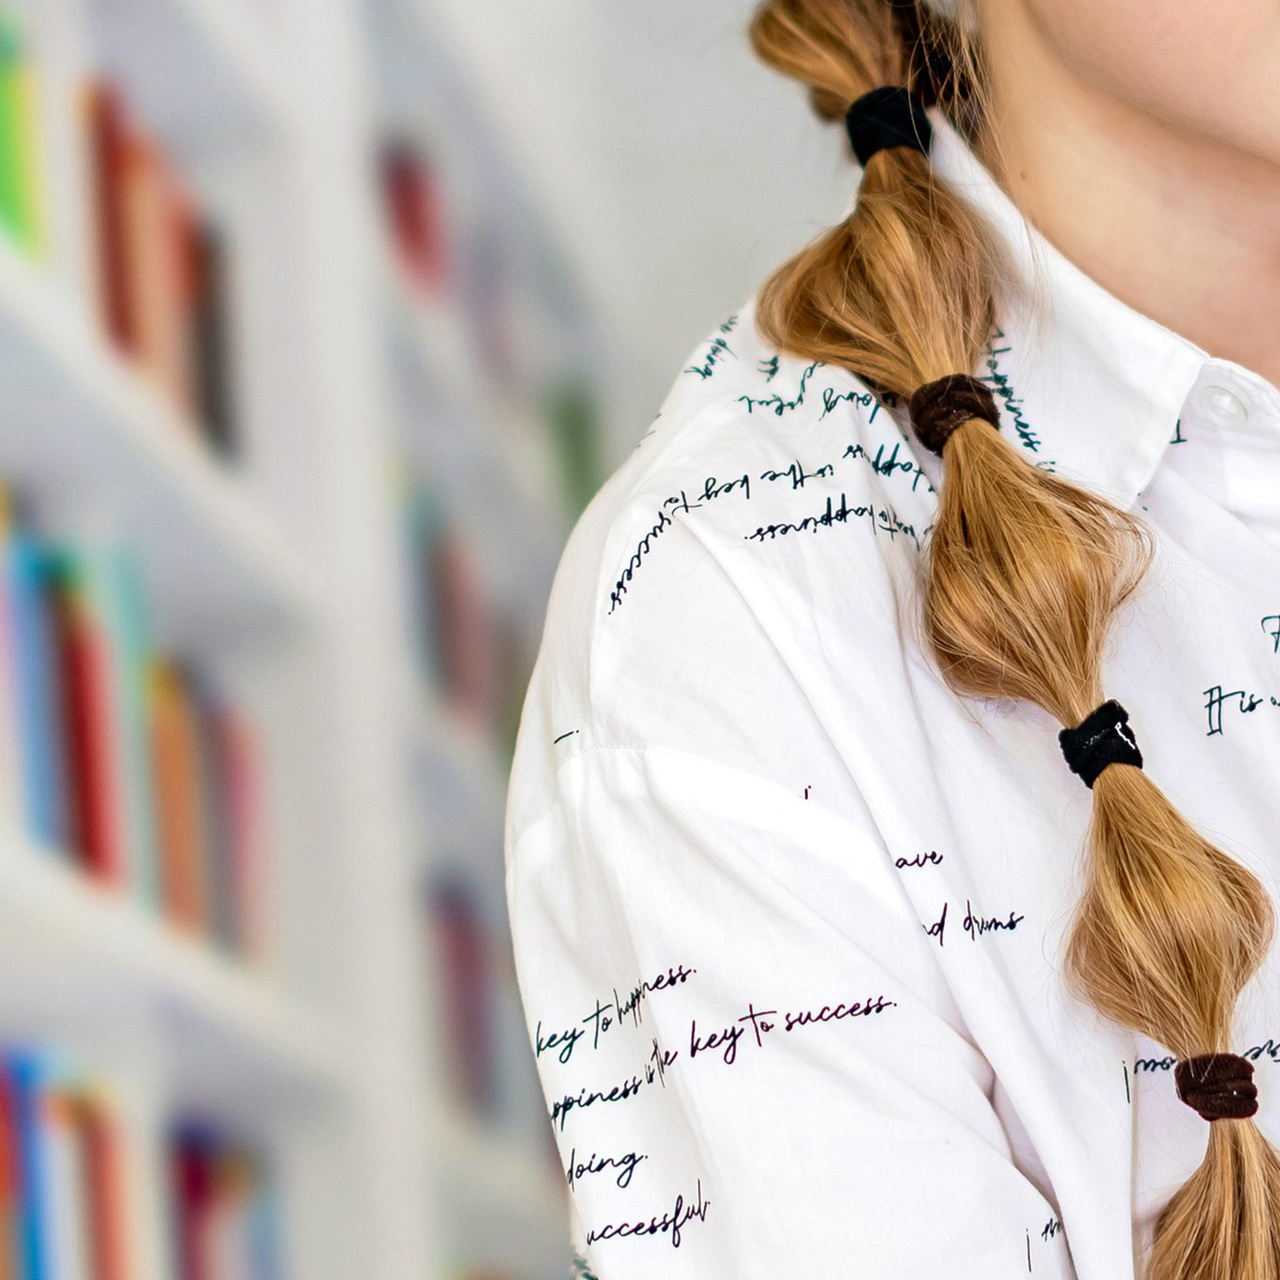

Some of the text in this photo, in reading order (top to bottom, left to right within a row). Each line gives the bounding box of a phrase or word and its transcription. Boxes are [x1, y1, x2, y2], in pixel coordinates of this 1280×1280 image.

[697, 474, 751, 500] key
[663, 490, 703, 517] to
[894, 850, 944, 870] ave
[688, 1018, 748, 1067] key
[738, 1001, 776, 1049] to
